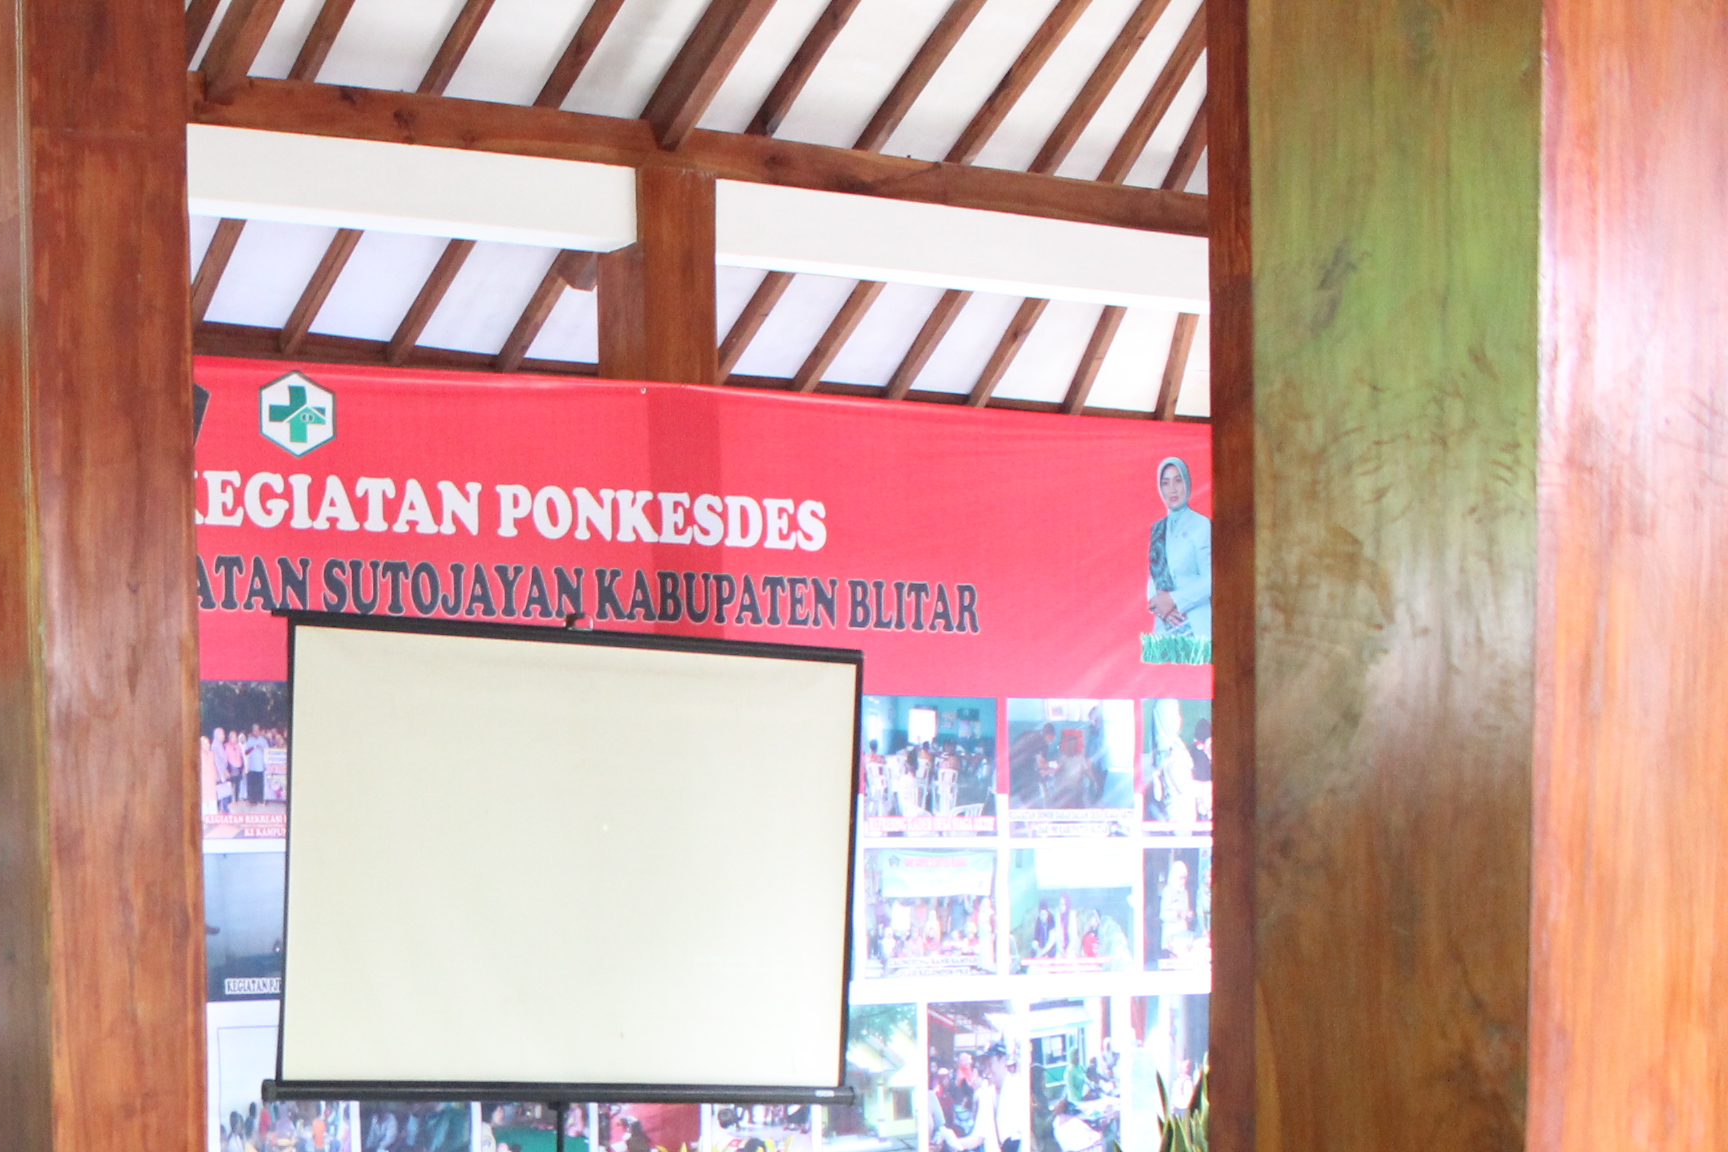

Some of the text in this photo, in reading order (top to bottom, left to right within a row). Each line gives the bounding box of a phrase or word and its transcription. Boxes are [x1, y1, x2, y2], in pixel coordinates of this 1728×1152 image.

[195, 470, 482, 536] EGIATAN
[495, 483, 827, 552] PONKESDES
[197, 554, 311, 612] ATAN
[322, 557, 584, 619] SUTOJAYAN
[594, 567, 839, 628] KABUPATEN
[846, 578, 981, 634] BLITAR
[205, 816, 244, 824] KEGIATAN
[227, 978, 268, 992] KEGIATAN
